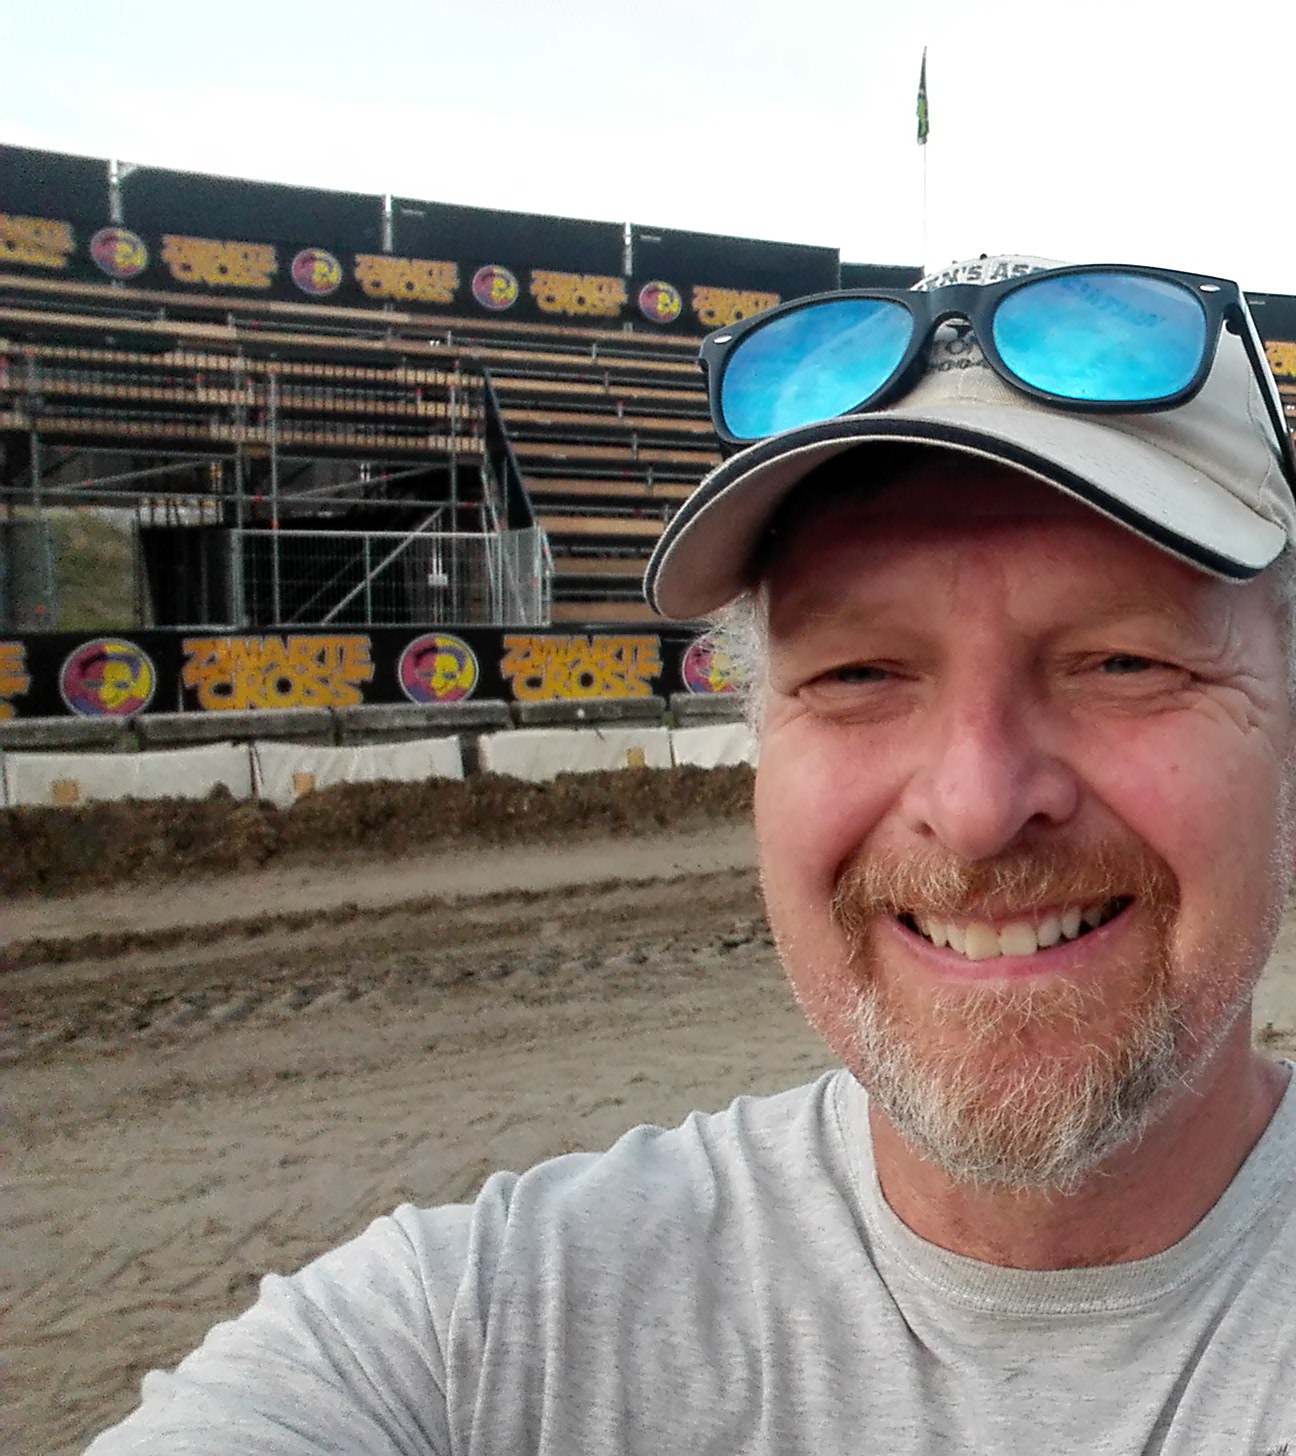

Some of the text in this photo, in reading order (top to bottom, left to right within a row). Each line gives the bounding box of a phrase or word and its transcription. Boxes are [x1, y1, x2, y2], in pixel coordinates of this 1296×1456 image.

[182, 634, 375, 685] ZWARTE
[502, 634, 664, 677] ZWARTE
[196, 668, 364, 710] CROSS
[512, 664, 653, 701] CROSS
